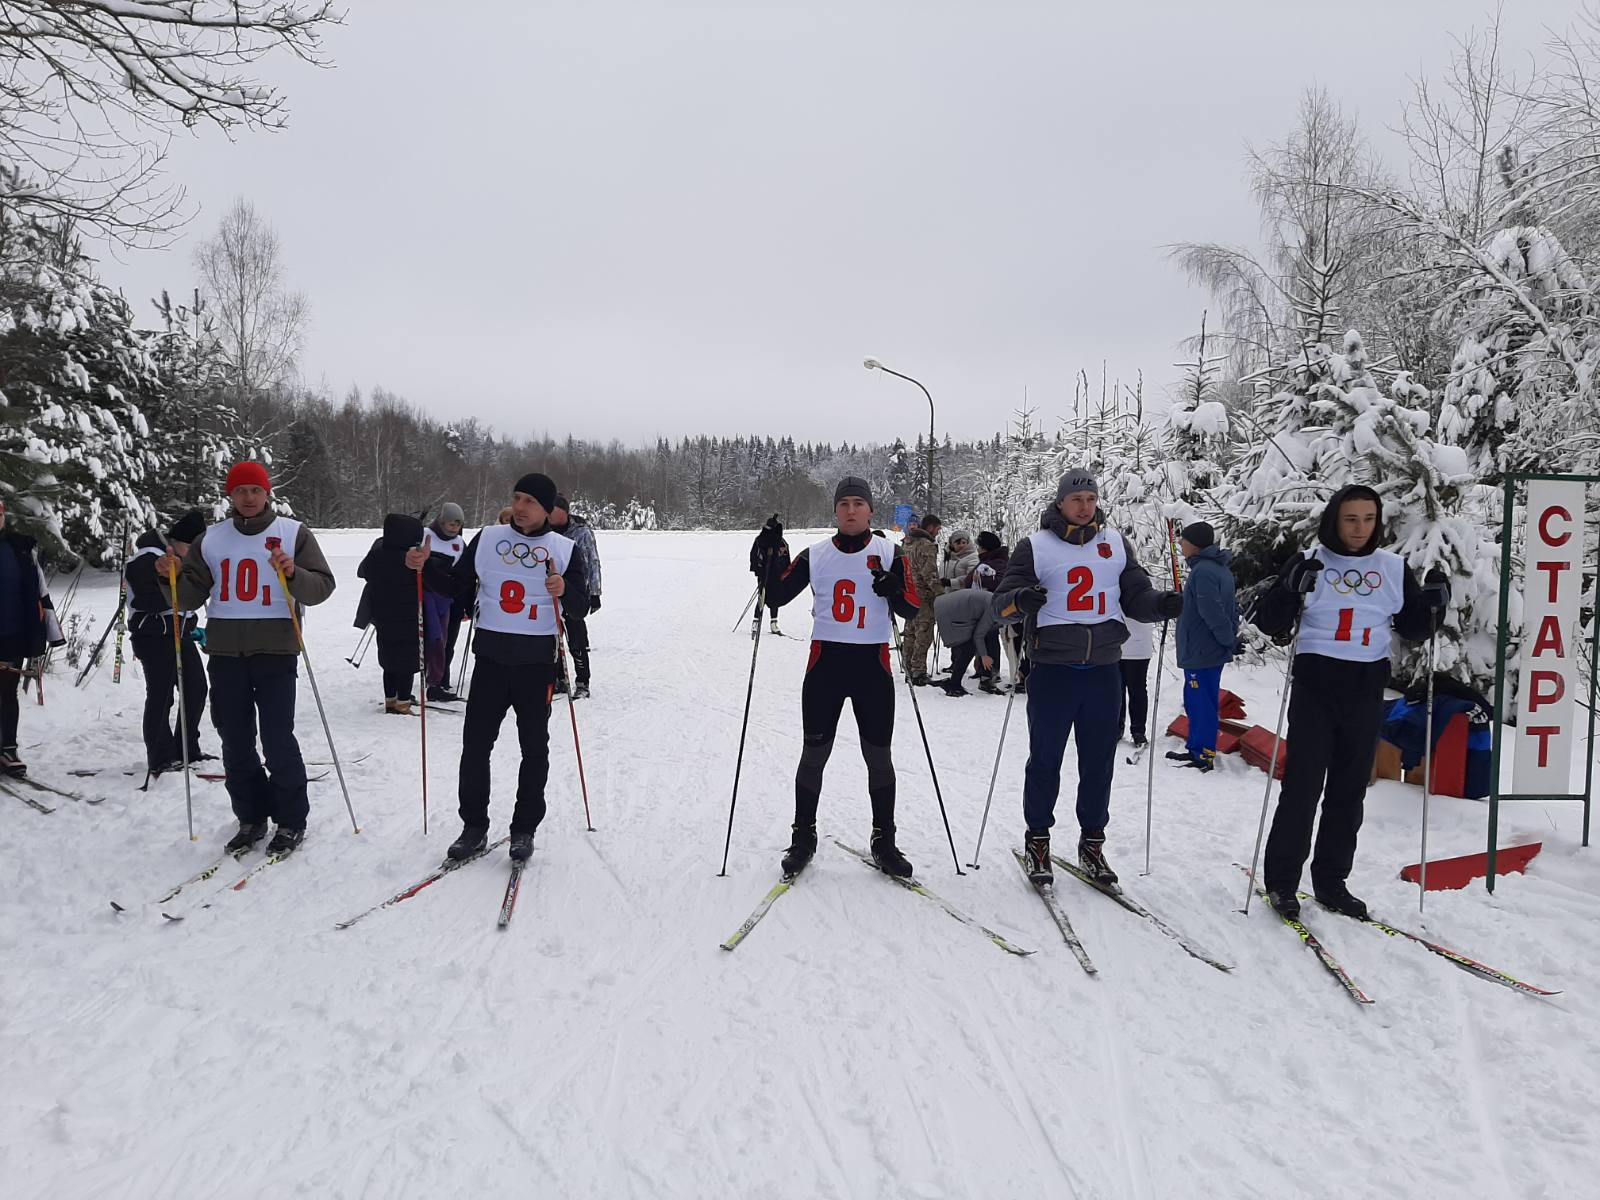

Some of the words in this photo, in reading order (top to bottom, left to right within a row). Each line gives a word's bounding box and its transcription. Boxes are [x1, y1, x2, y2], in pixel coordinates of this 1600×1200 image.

[1072, 477, 1093, 486] UFC
[220, 558, 259, 603] 10
[499, 579, 526, 615] 8
[830, 578, 857, 624] 6
[1066, 565, 1095, 613] 2
[1334, 607, 1355, 642] 1
[1527, 506, 1570, 769] СТАРТ
